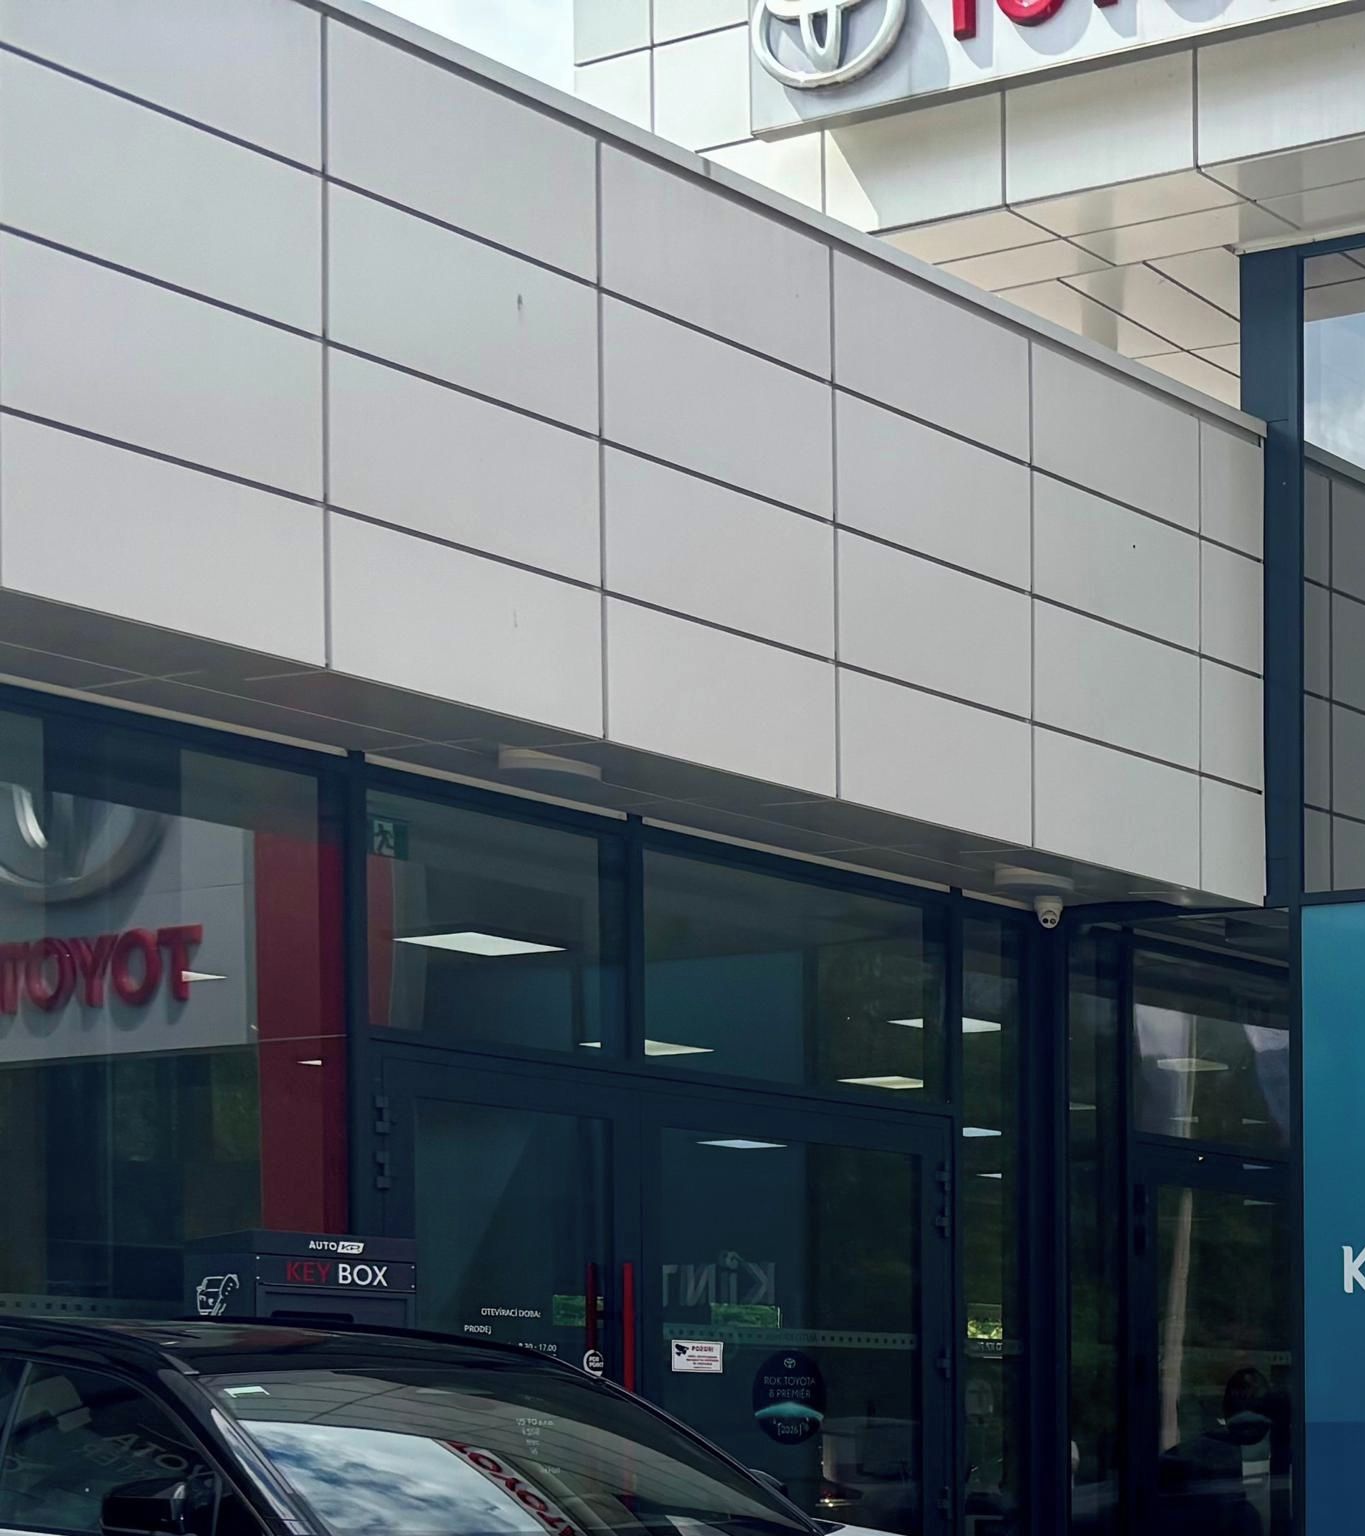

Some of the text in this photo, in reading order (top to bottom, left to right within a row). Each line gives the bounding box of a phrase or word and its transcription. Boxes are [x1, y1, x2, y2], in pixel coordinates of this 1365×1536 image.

[308, 1240, 338, 1251] AUTO
[286, 1261, 388, 1286] KEY BOX
[463, 1324, 492, 1335] PRODEJ
